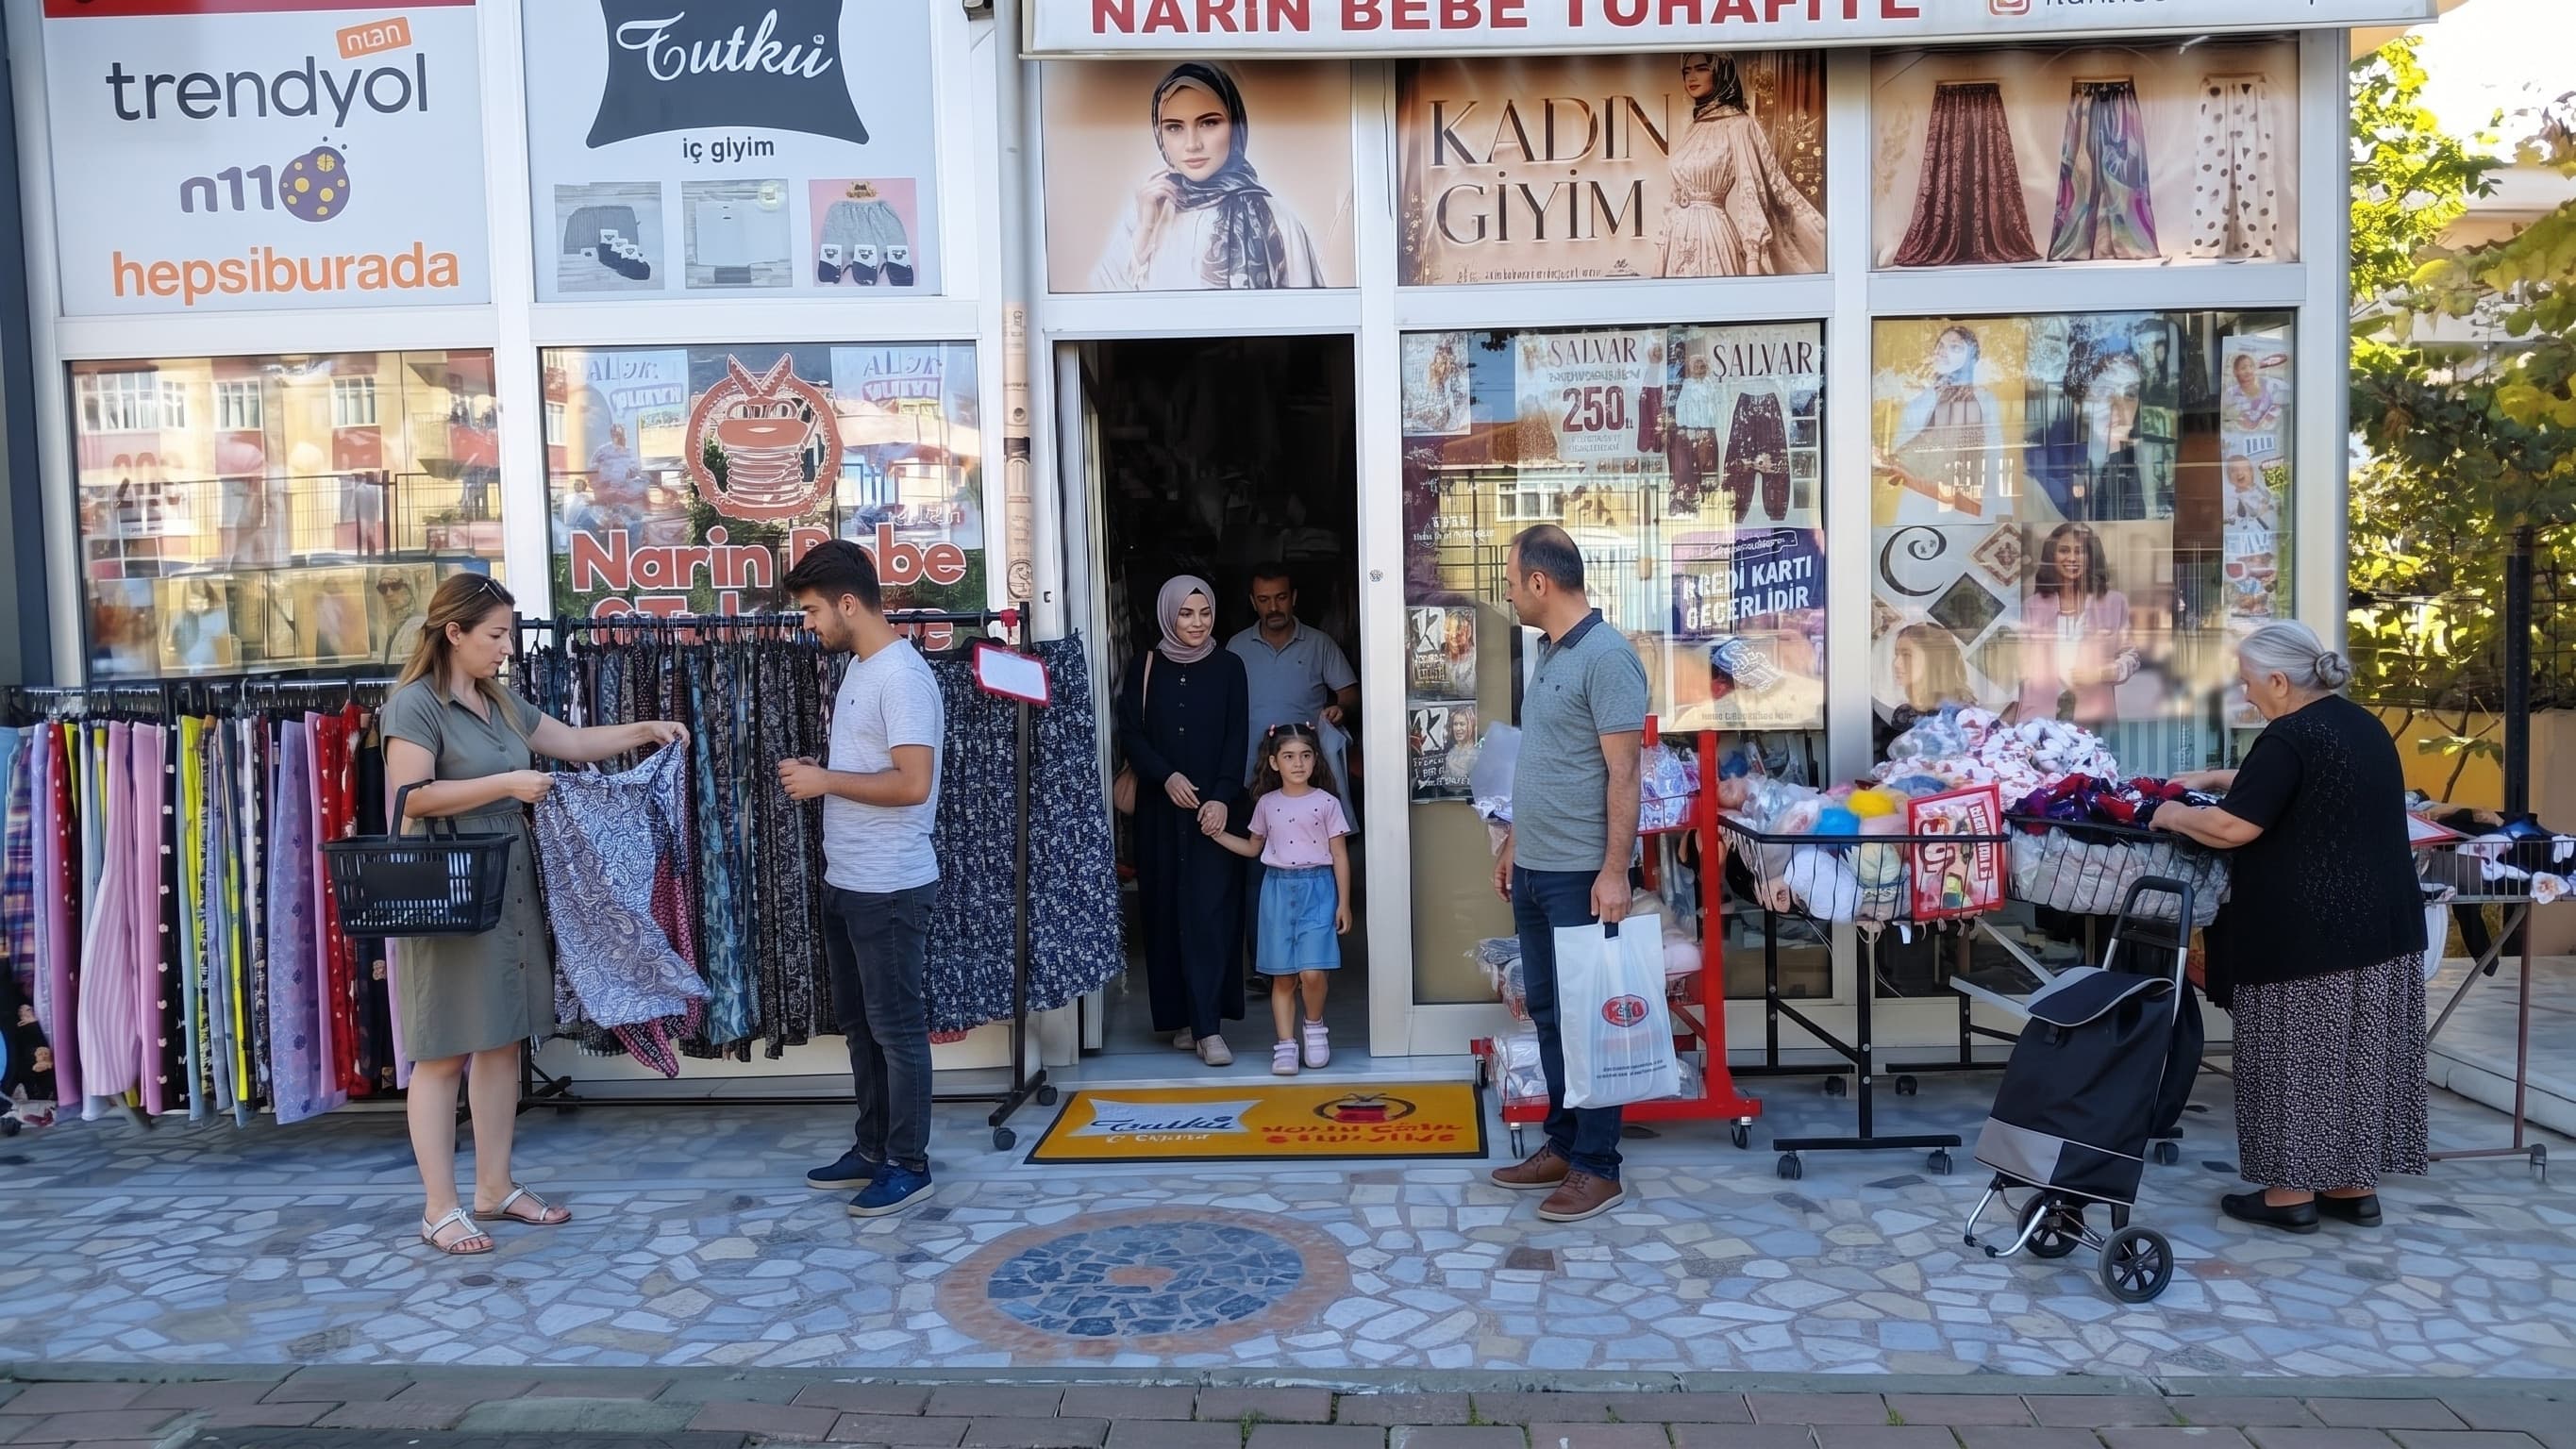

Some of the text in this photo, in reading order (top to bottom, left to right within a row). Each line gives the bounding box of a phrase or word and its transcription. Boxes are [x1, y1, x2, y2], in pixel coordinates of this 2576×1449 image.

[1341, 0, 1529, 31] BEBE
[105, 53, 428, 127] trendyol
[682, 137, 703, 164] iç
[1428, 93, 1669, 167] KADIN
[1435, 168, 1647, 245] GİYİM
[112, 242, 460, 306] hepsiburada
[1712, 341, 1814, 383] ŞALVAR
[1562, 385, 1625, 433] 250
[570, 525, 774, 592] Narin
[1751, 556, 1813, 588] KARTI
